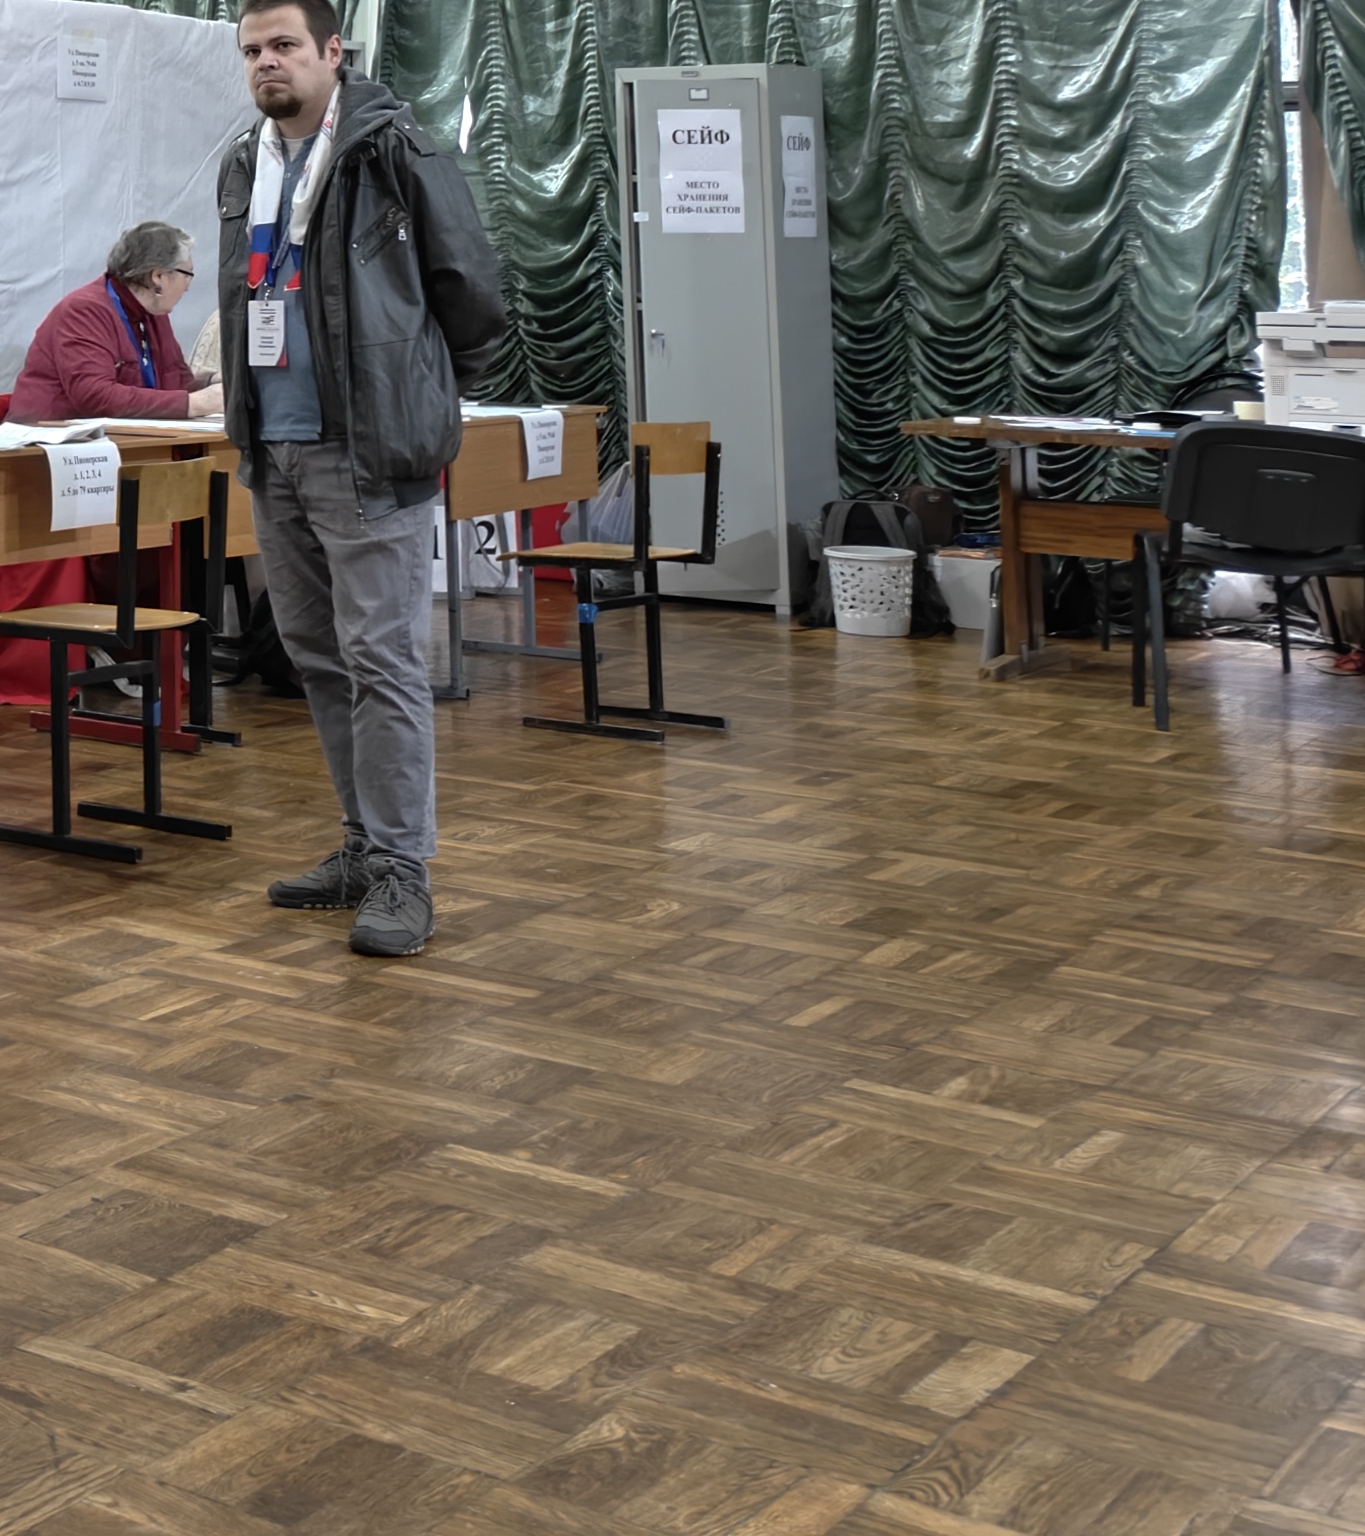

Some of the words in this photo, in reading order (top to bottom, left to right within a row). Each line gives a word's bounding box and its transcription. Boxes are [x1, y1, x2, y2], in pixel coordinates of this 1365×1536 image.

[671, 125, 730, 146] СЕЙФ
[786, 132, 811, 152] СЕЙФ
[685, 180, 720, 190] МЕСТО
[676, 193, 729, 202] ХРАНЕНИЯ
[666, 204, 741, 215] СЕЙФ-ПАКЕТОВ
[473, 520, 498, 555] 2
